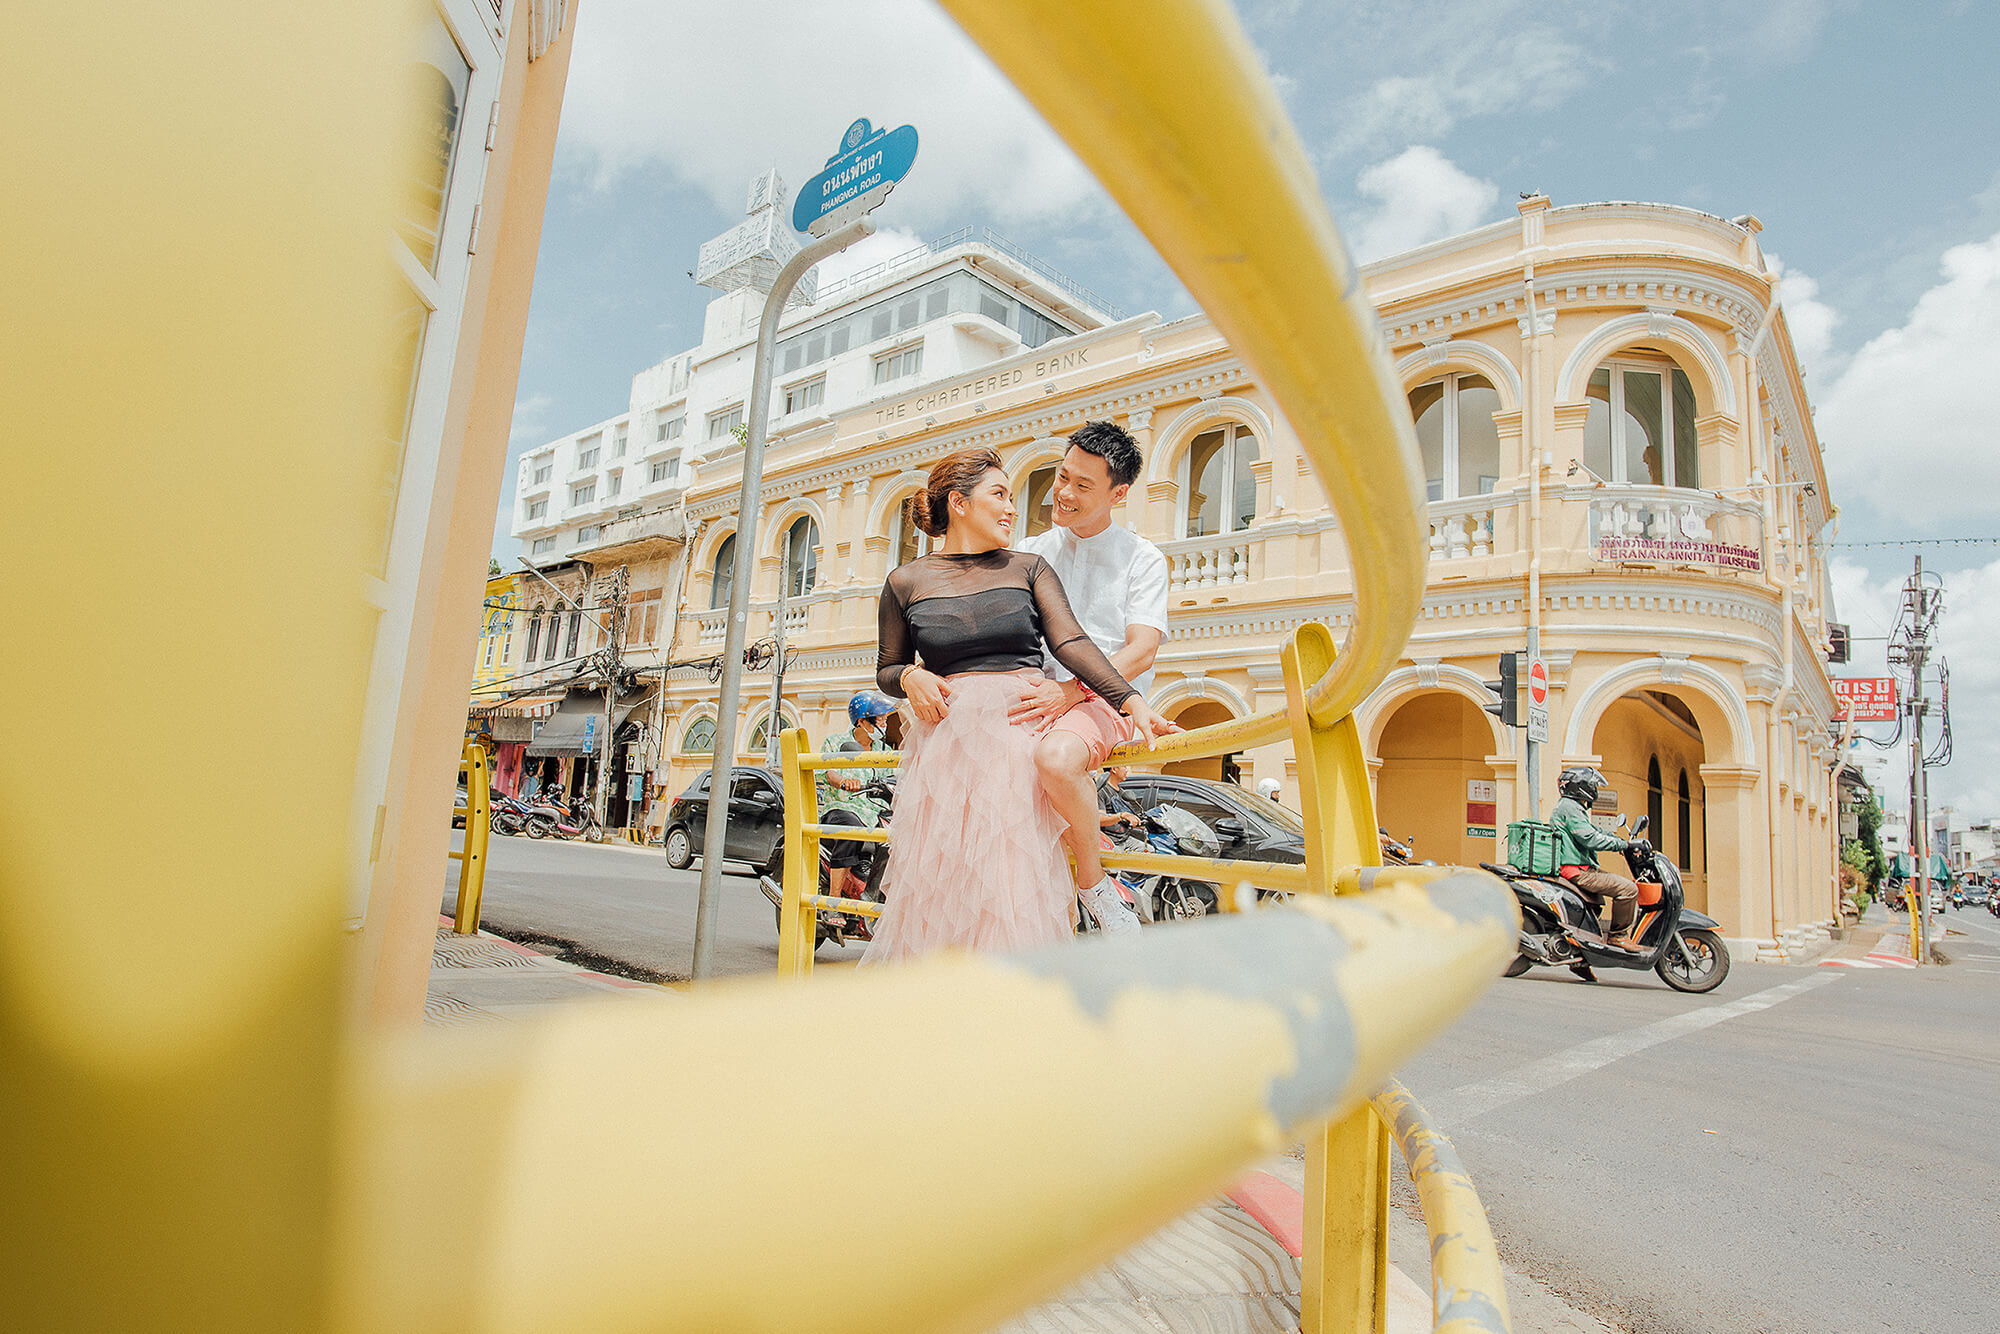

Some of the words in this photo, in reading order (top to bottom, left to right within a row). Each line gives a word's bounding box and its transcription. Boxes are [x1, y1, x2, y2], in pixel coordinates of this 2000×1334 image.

[820, 185, 858, 213] PHANGNGA
[860, 172, 881, 192] ROAD
[822, 150, 883, 196] ถนนพังงา
[876, 403, 906, 424] THE
[915, 369, 1023, 412] CHARTERED
[1035, 348, 1089, 377] BANK
[1600, 549, 1716, 562] PERANAKANNITAT
[1718, 556, 1760, 571] MUSEUM
